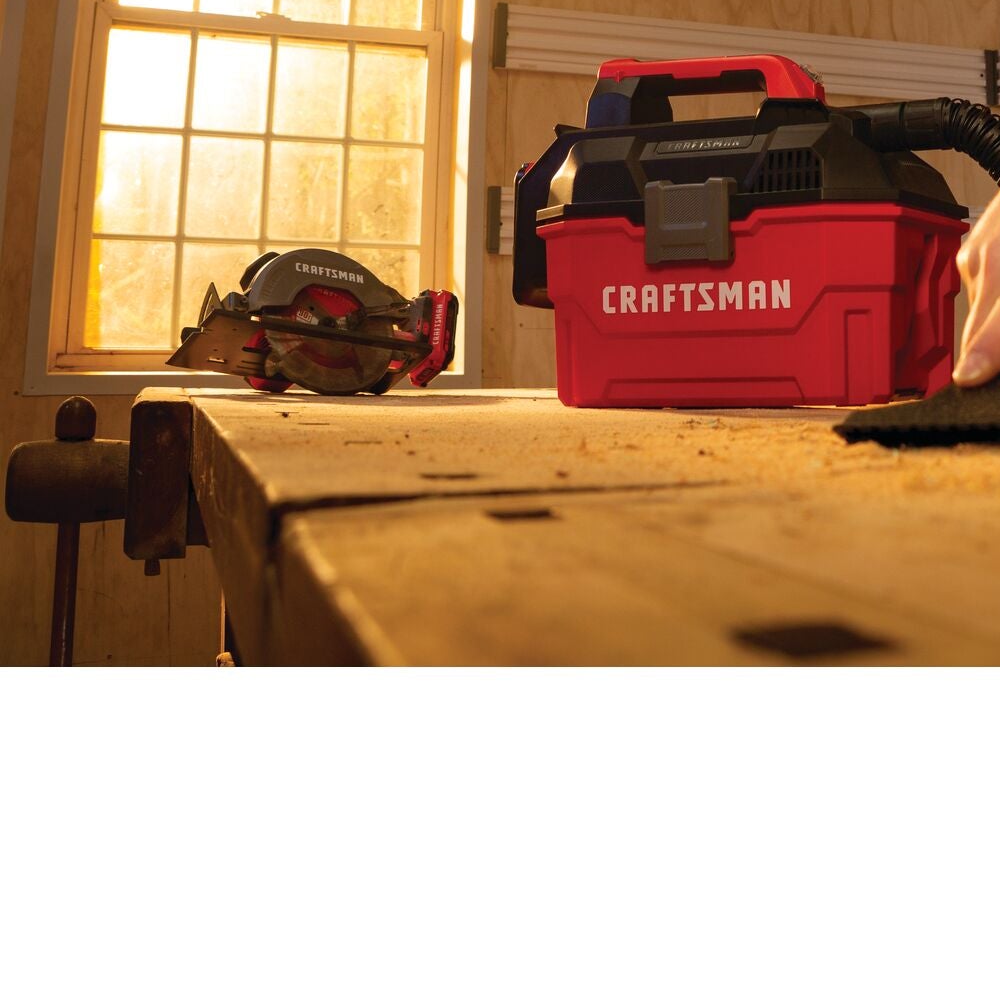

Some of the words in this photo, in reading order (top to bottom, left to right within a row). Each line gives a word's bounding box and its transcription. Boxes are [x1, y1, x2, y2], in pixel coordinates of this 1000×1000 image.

[295, 262, 364, 284] CRAFTSMAN
[602, 279, 791, 313] CRAFTSMAN
[432, 304, 444, 345] CRAFTSMAN
